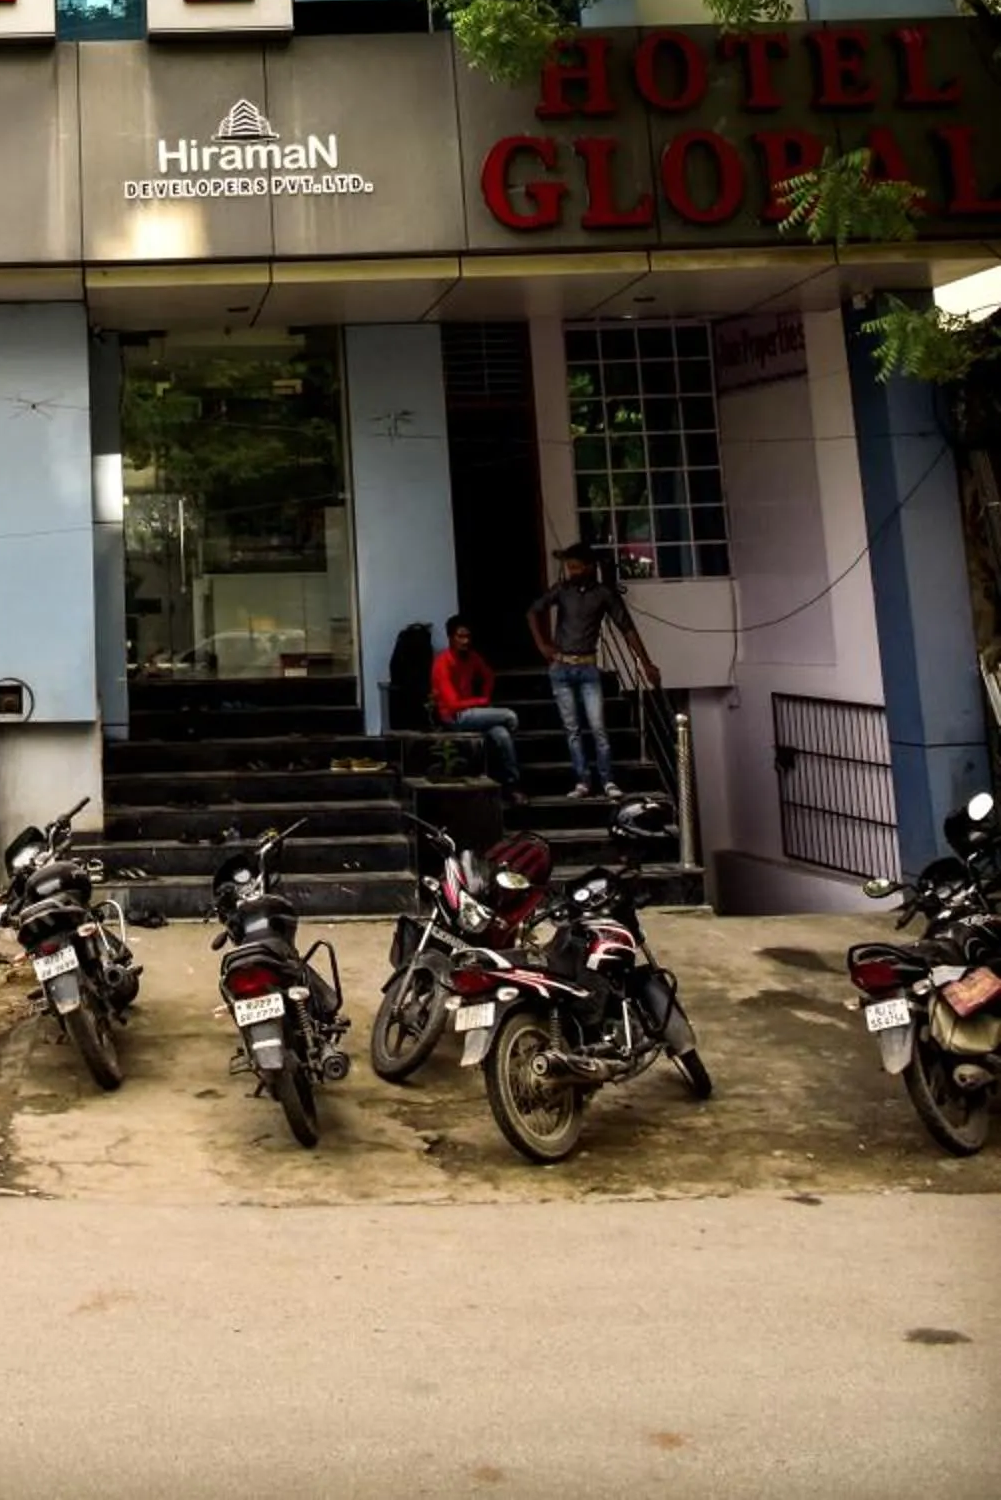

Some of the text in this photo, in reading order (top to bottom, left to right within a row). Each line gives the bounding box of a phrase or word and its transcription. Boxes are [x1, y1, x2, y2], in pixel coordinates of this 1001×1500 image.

[535, 26, 963, 121] HOTEL
[157, 133, 339, 174] HiramaN
[124, 177, 268, 199] DEVELOPERS
